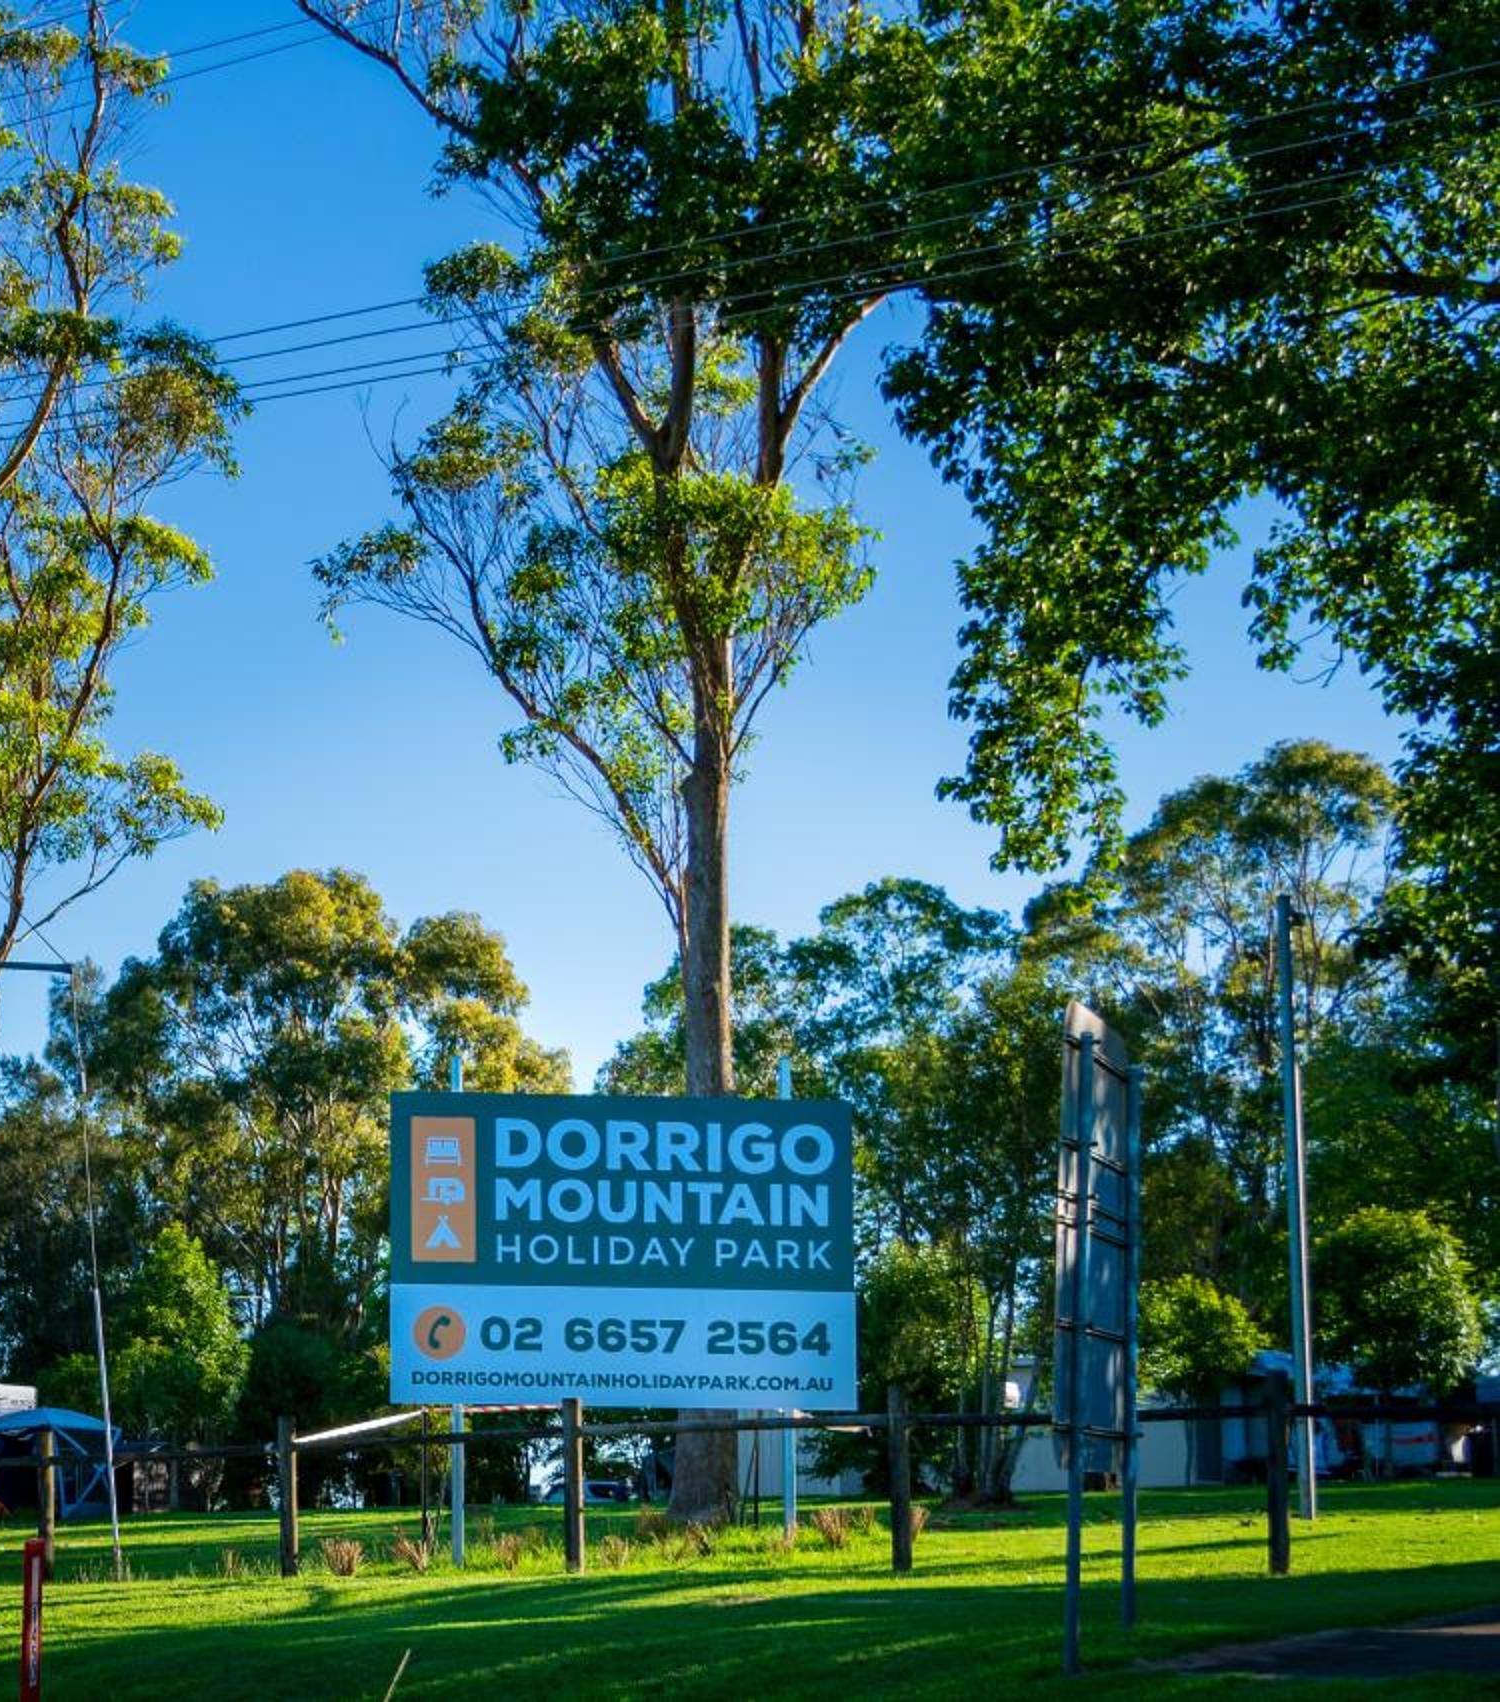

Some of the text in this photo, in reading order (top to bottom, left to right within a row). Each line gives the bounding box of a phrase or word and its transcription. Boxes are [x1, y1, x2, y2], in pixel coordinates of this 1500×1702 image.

[495, 1118, 835, 1175] DORRIGO
[495, 1179, 829, 1227] MOUNTAIN
[496, 1235, 833, 1270] HOLIDAY PARK
[480, 1316, 831, 1356] 02 6657 2564
[411, 1371, 833, 1392] DORRIGOMOUNTAINHOLIDAYPARK.COM.AU
